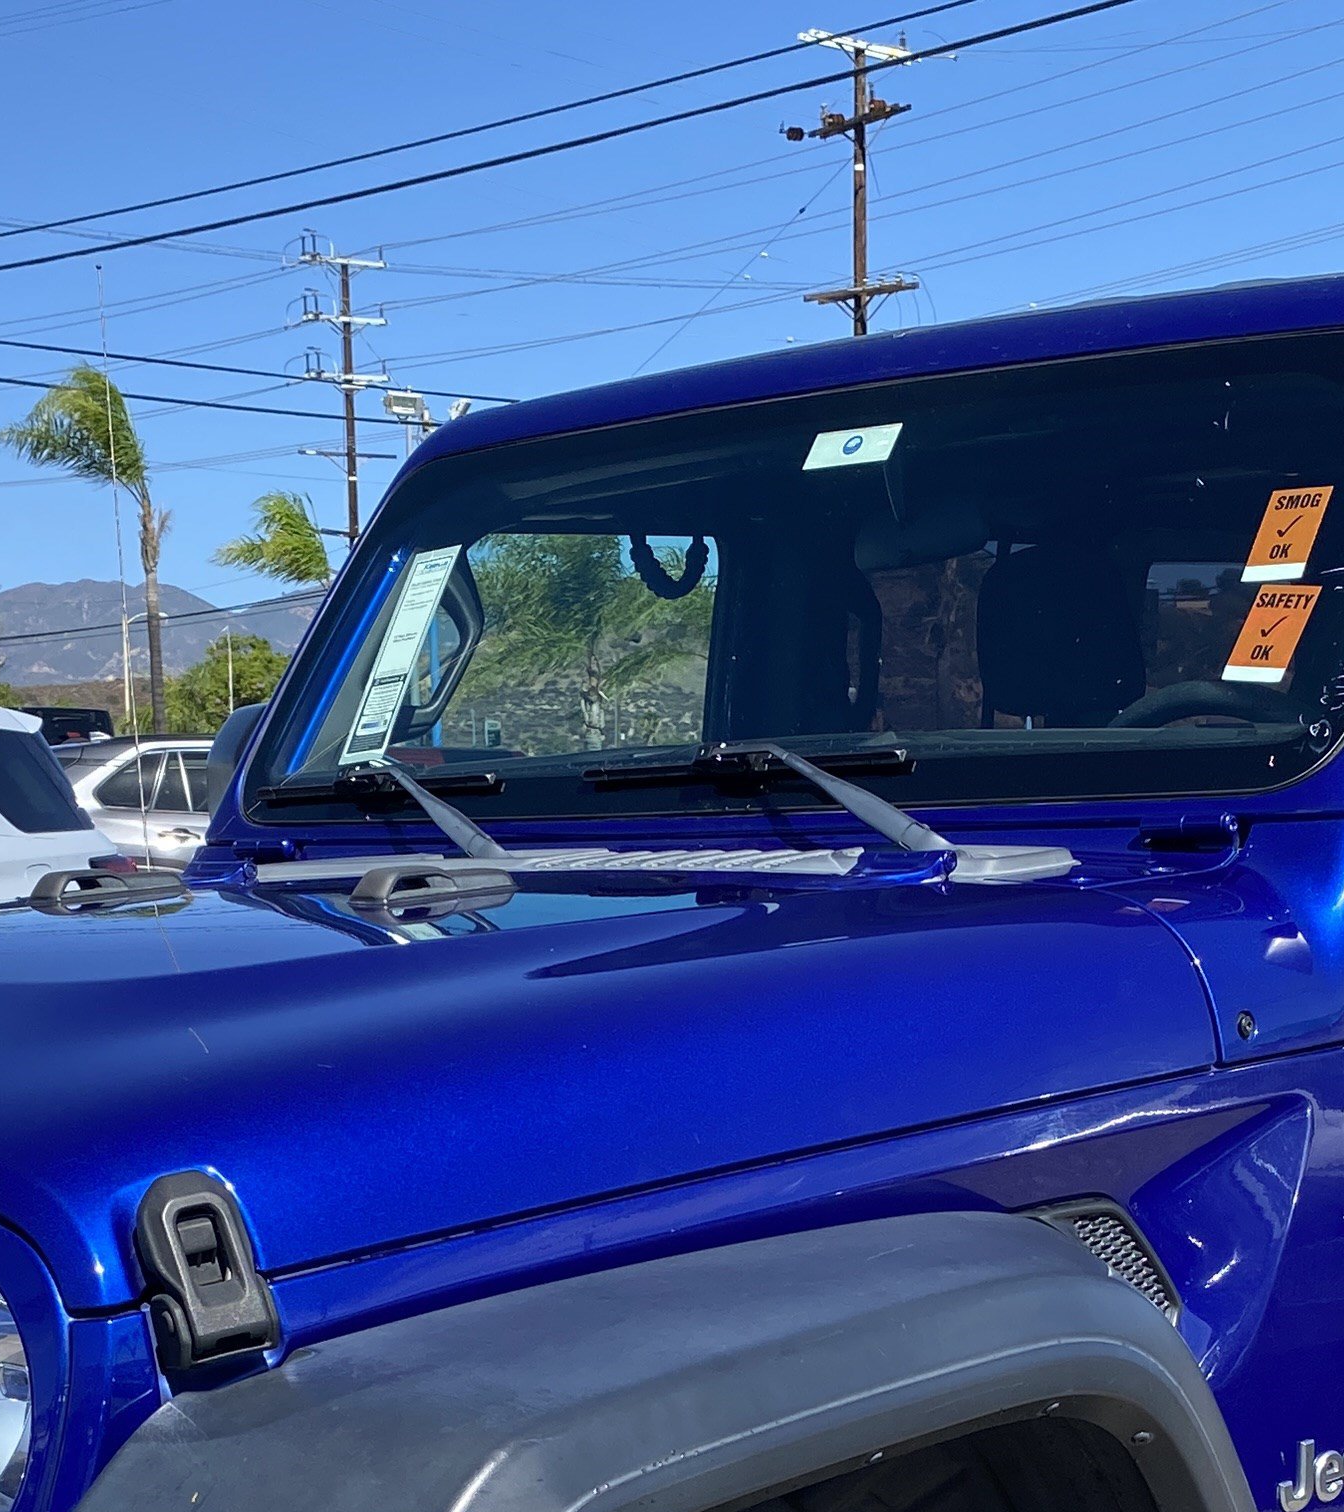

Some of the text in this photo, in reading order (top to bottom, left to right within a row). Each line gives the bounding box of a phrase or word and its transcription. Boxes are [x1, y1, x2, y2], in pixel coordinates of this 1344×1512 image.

[1274, 493, 1323, 510] SMOG
[1268, 543, 1292, 560] OK
[1256, 592, 1315, 610] SAFETY
[1250, 645, 1274, 661] OK
